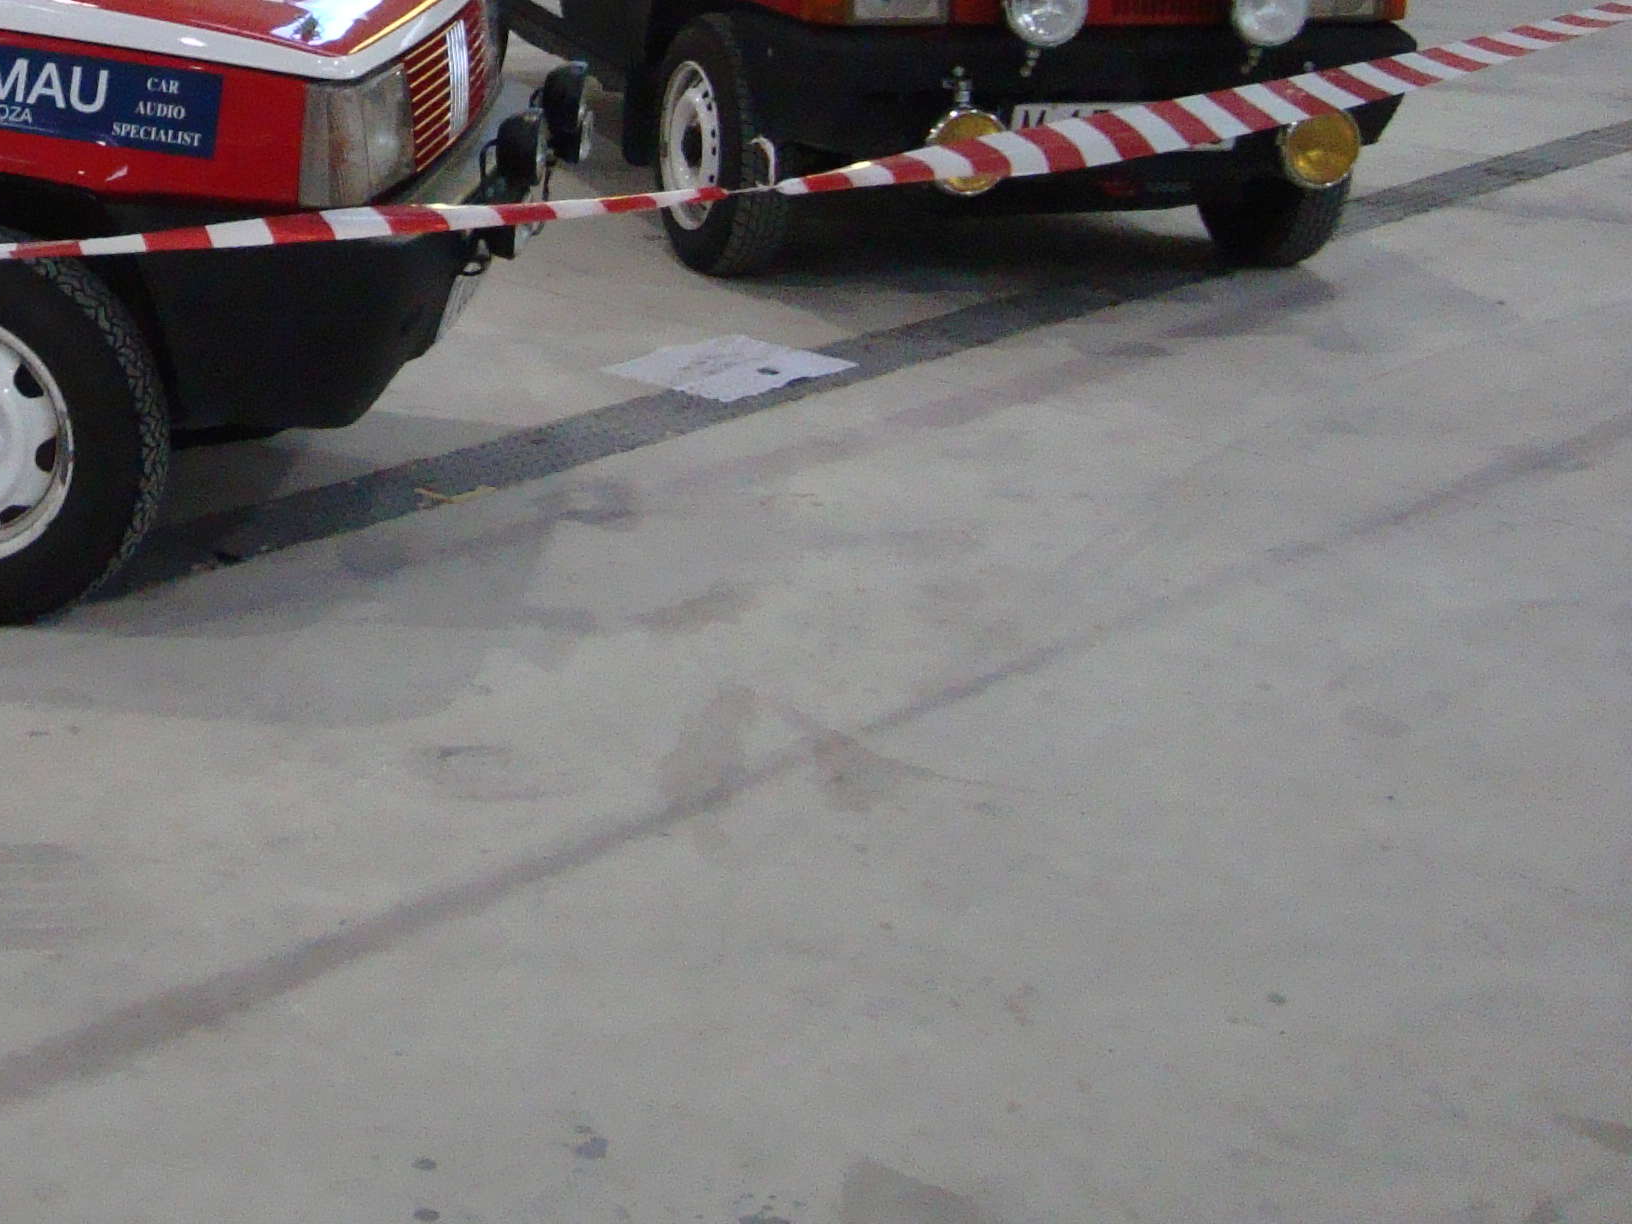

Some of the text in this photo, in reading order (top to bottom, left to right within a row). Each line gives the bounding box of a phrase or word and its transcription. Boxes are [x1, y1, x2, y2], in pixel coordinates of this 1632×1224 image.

[146, 77, 180, 95] CAR
[135, 100, 186, 120] AUDIO
[111, 122, 202, 148] SPECIALIST
